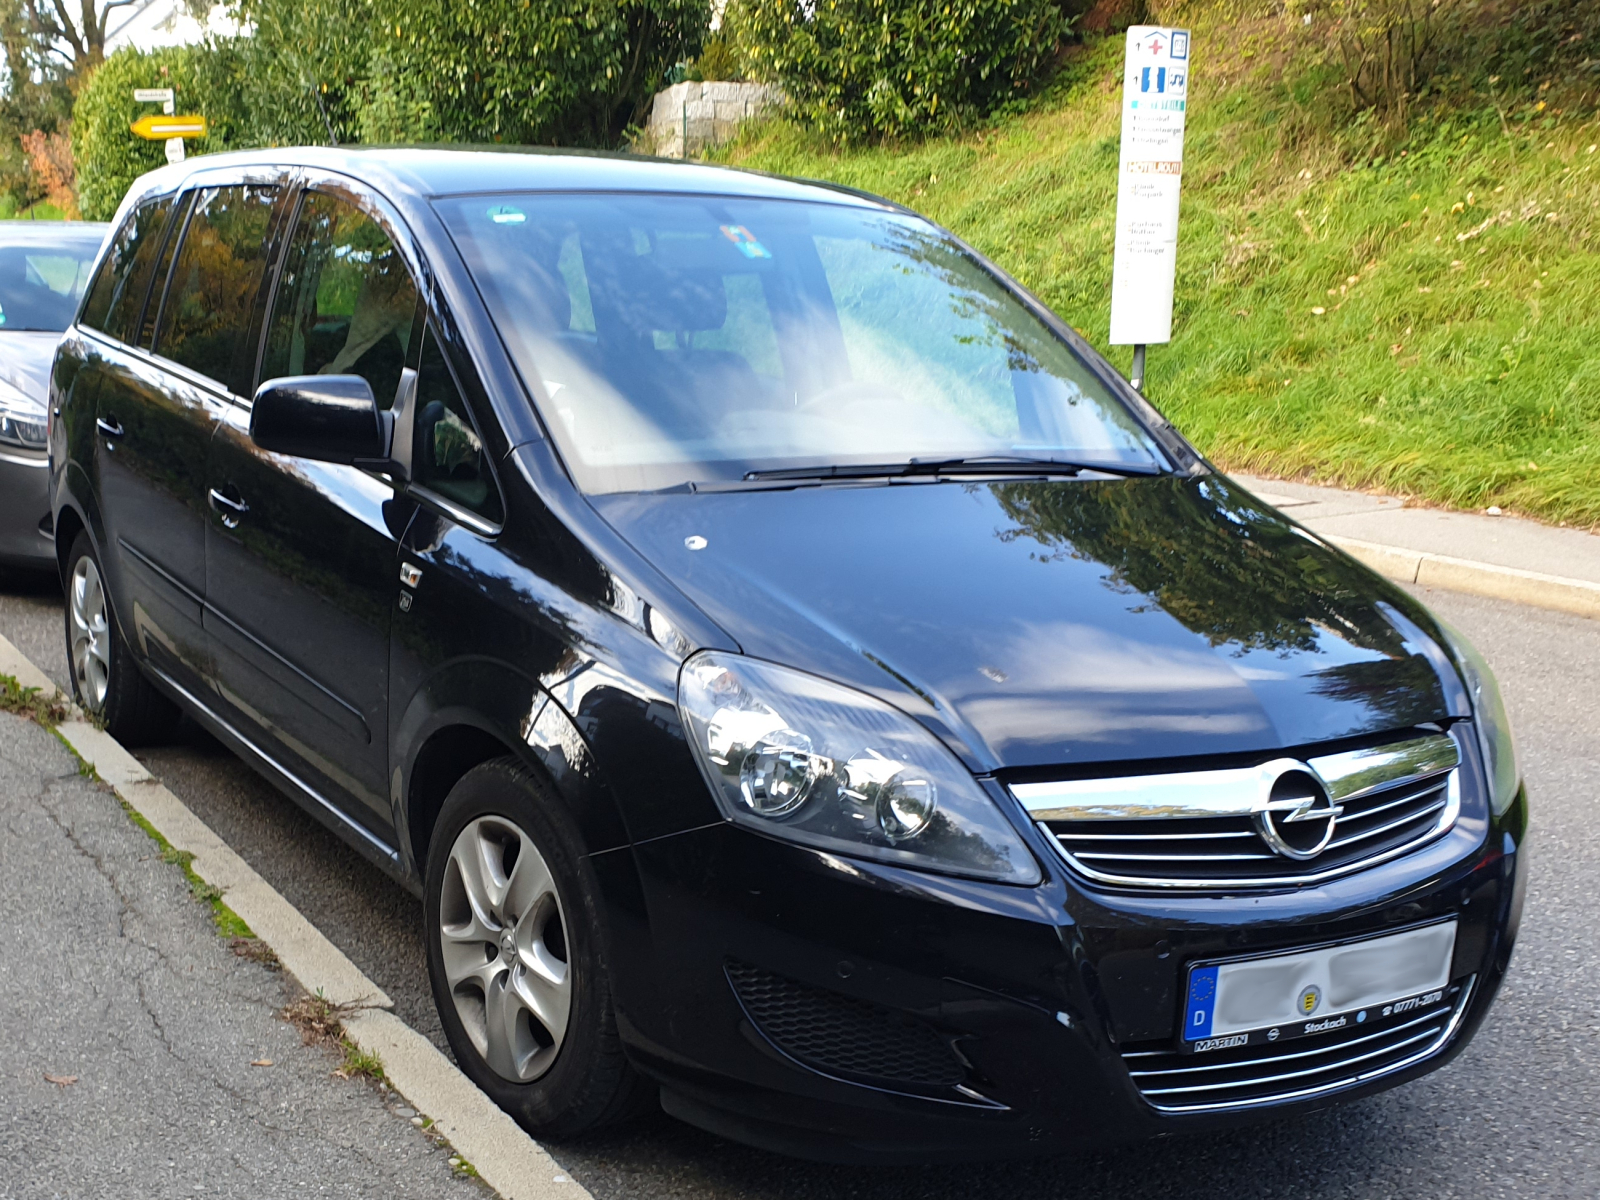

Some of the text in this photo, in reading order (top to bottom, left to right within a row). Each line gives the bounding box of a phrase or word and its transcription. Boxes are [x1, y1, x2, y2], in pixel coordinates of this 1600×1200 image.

[1193, 1010, 1206, 1026] D
[1194, 991, 1443, 1053] MARTIN Stockach 07771-2070
